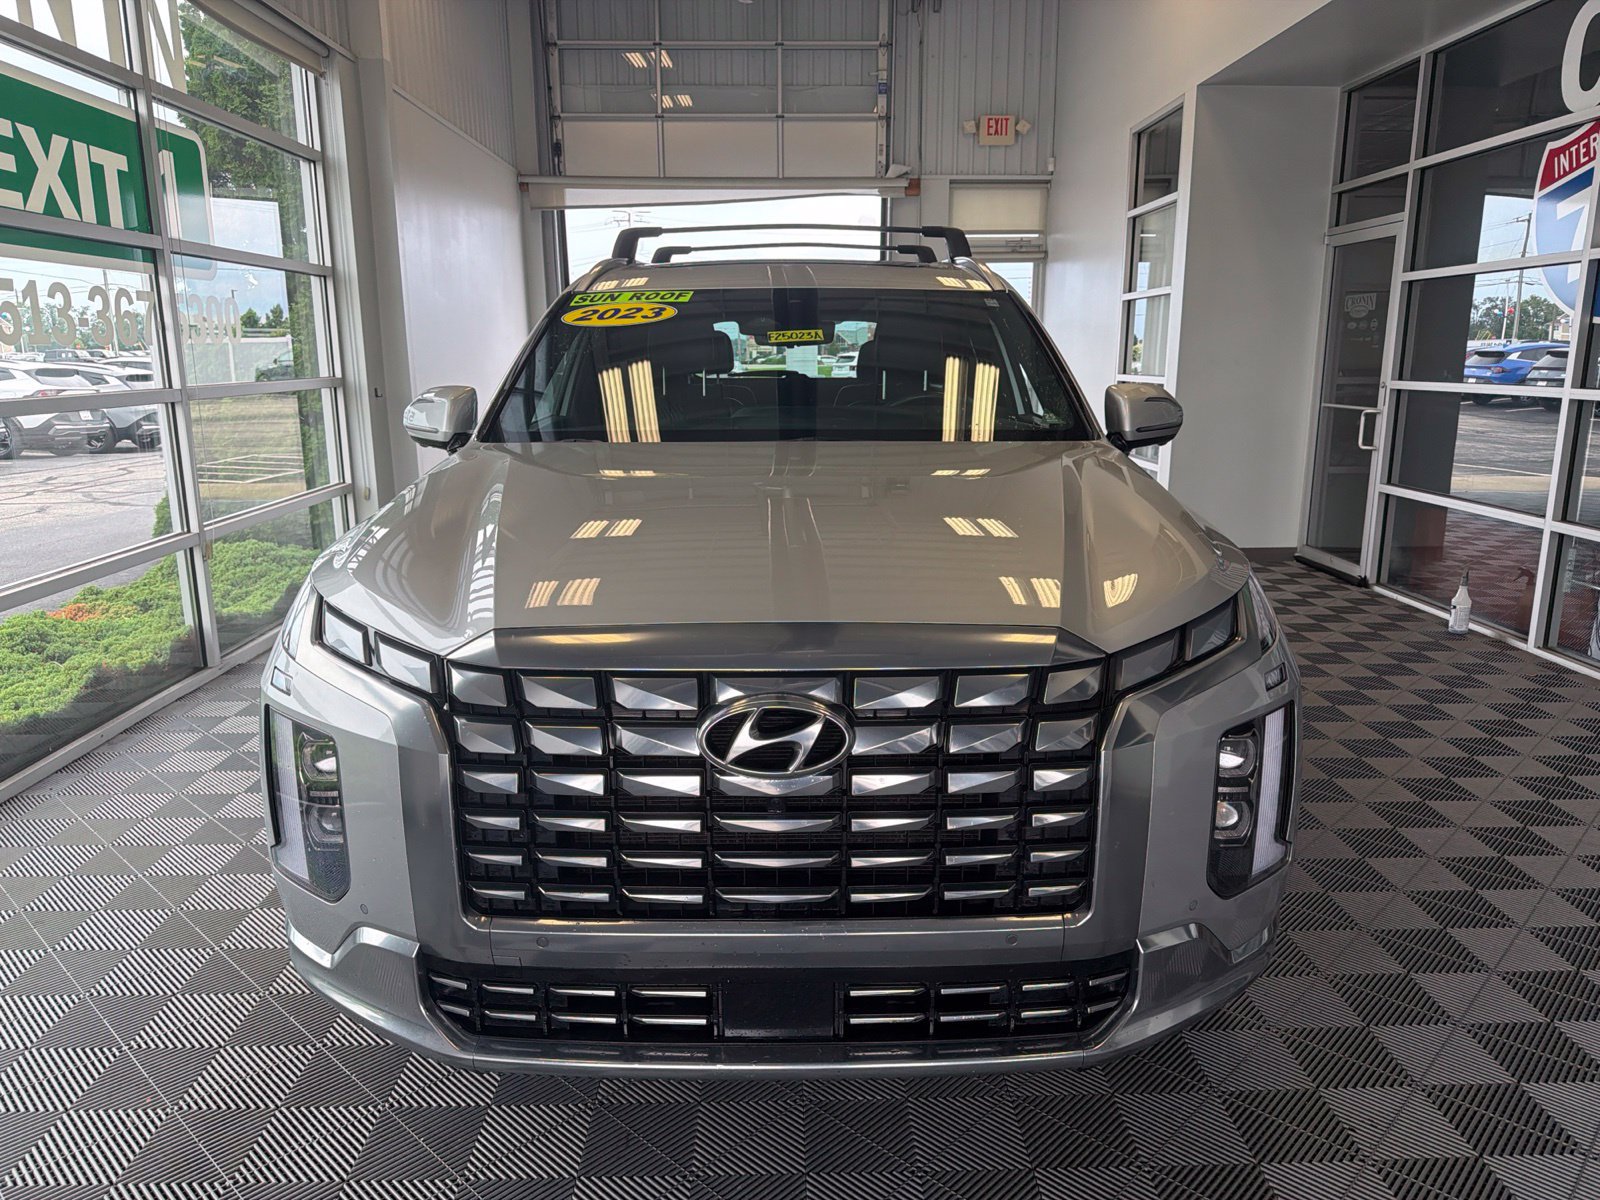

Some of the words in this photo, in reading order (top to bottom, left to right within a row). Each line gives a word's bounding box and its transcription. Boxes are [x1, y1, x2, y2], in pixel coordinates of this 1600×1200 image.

[986, 117, 1010, 136] EXIT
[0, 117, 128, 229] EXIT
[574, 293, 622, 304] SUN
[627, 291, 690, 301] ROOF
[572, 306, 667, 322] 2023
